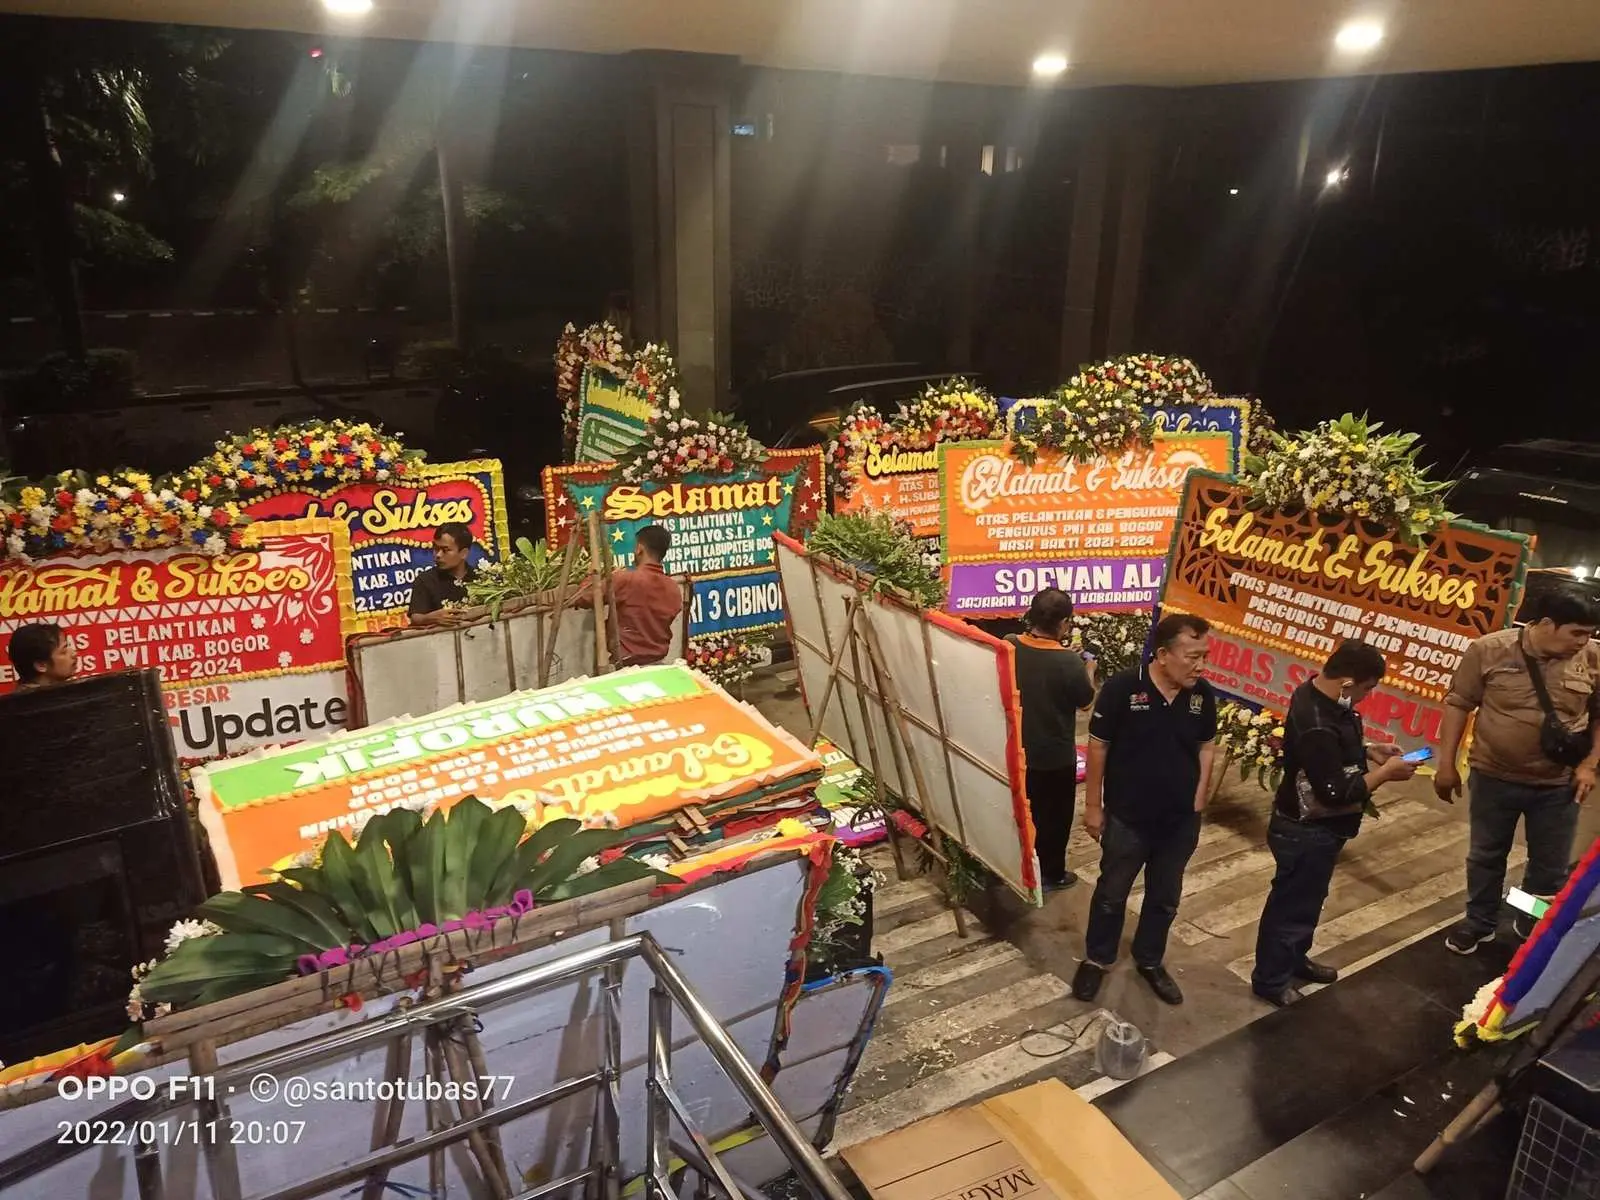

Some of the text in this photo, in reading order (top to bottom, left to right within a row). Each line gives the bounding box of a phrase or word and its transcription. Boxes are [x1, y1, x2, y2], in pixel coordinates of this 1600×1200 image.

[899, 480, 924, 492] ATAS
[970, 455, 1081, 498] Selamat
[1110, 449, 1189, 490] Sukse
[362, 489, 473, 534] Sukses
[604, 475, 783, 520] Selamat
[680, 512, 745, 530] DILANTIKNYA
[976, 514, 1009, 526] ATAS
[1012, 509, 1093, 524] PELANTIKAN
[1107, 506, 1180, 520] PENGUKUH
[988, 526, 1057, 539] PENGURUS
[1088, 523, 1113, 534] KAB
[1119, 520, 1163, 533] BOGOR
[671, 525, 755, 547] BAGIYO.S.I.P
[684, 545, 702, 560] PWI
[703, 538, 755, 558] KABUPATEN
[999, 535, 1154, 551] MASA BAKTI 2021-2024
[352, 549, 411, 571] NTIKAN
[669, 561, 699, 575] BAKTI
[702, 558, 724, 572] 2021
[730, 553, 755, 568] 2024
[1200, 507, 1477, 609] Selamat & Sukses
[0, 553, 309, 617] lamat & Sukses
[358, 574, 393, 592] KAB.
[1122, 563, 1162, 589] AL
[708, 590, 721, 620] 3
[957, 596, 1016, 609] JAJARAN
[1080, 590, 1152, 604] KABARINDO
[1229, 571, 1266, 593] ATAS
[1266, 582, 1362, 622] PELANTIKAN
[1361, 611, 1375, 624] &
[105, 616, 236, 647] PELANTIKAN
[1248, 595, 1328, 631] PENGURUS
[1363, 630, 1403, 653] KAB
[103, 645, 149, 670] PWI
[158, 643, 201, 663] KAB.
[205, 634, 270, 657] BOGOR
[1242, 612, 1283, 637] MASA
[1285, 625, 1335, 653] BAKTI
[1399, 661, 1453, 690] 2024
[163, 684, 231, 709] BESAR
[179, 696, 348, 754] Update
[542, 732, 751, 813] Selamat
